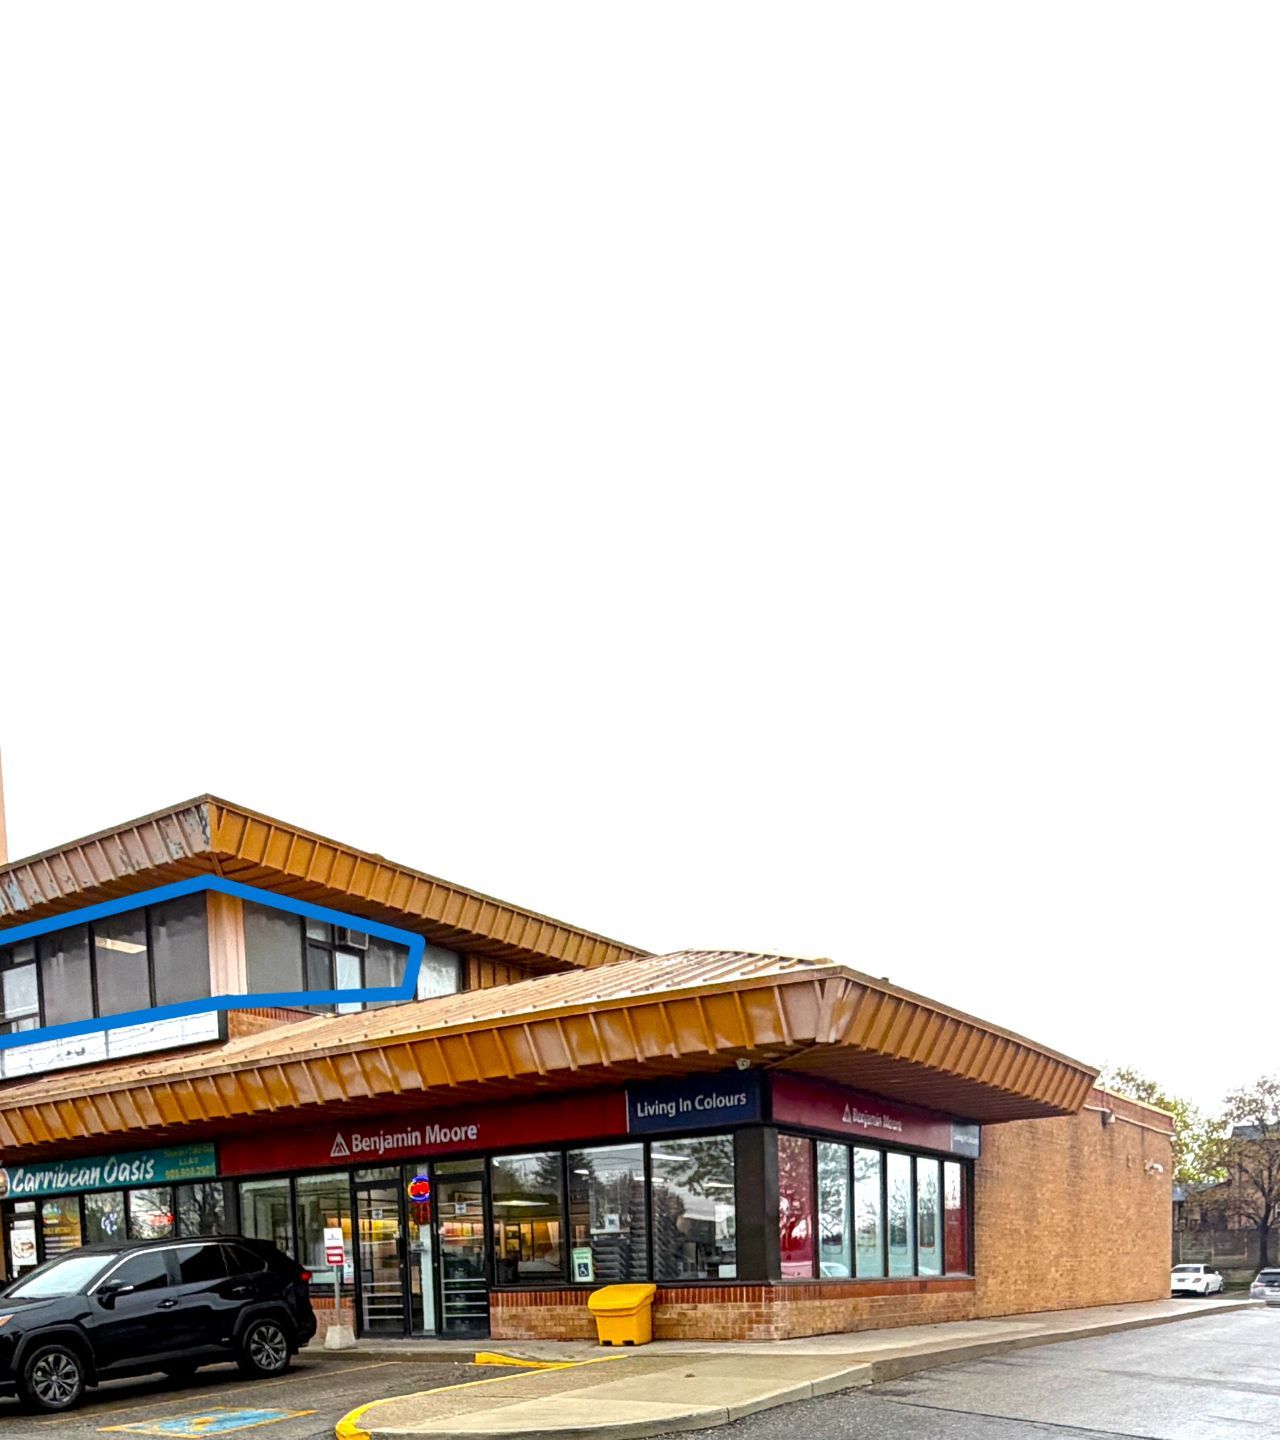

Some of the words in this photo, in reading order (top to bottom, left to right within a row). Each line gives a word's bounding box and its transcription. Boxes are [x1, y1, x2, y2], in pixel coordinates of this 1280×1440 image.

[637, 1100, 676, 1118] Living
[679, 1098, 692, 1112] In
[695, 1092, 747, 1110] Colours
[351, 1126, 421, 1155] Benjamin
[425, 1123, 478, 1145] Moore
[12, 1163, 101, 1193] Carribean
[103, 1155, 156, 1184] Oasis
